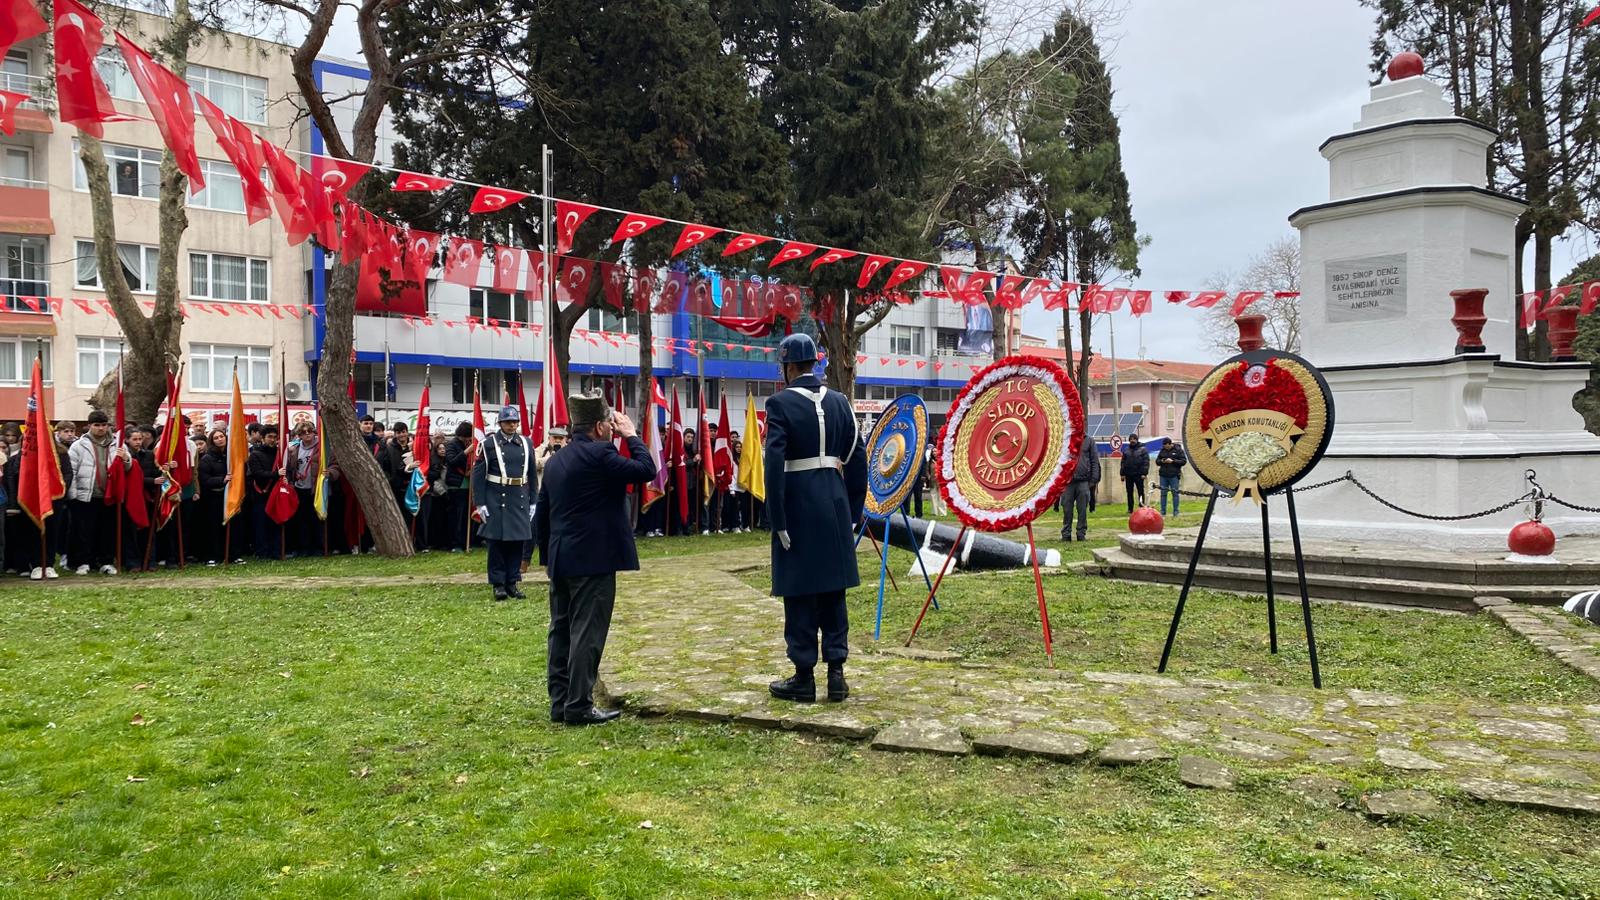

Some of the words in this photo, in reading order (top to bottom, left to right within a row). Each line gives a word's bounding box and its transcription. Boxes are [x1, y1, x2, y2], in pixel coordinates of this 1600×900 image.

[1376, 266, 1398, 277] DENİZ
[1351, 300, 1379, 309] ANISINA
[988, 401, 1035, 422] SİNOP
[1214, 418, 1246, 434] GARNİZON
